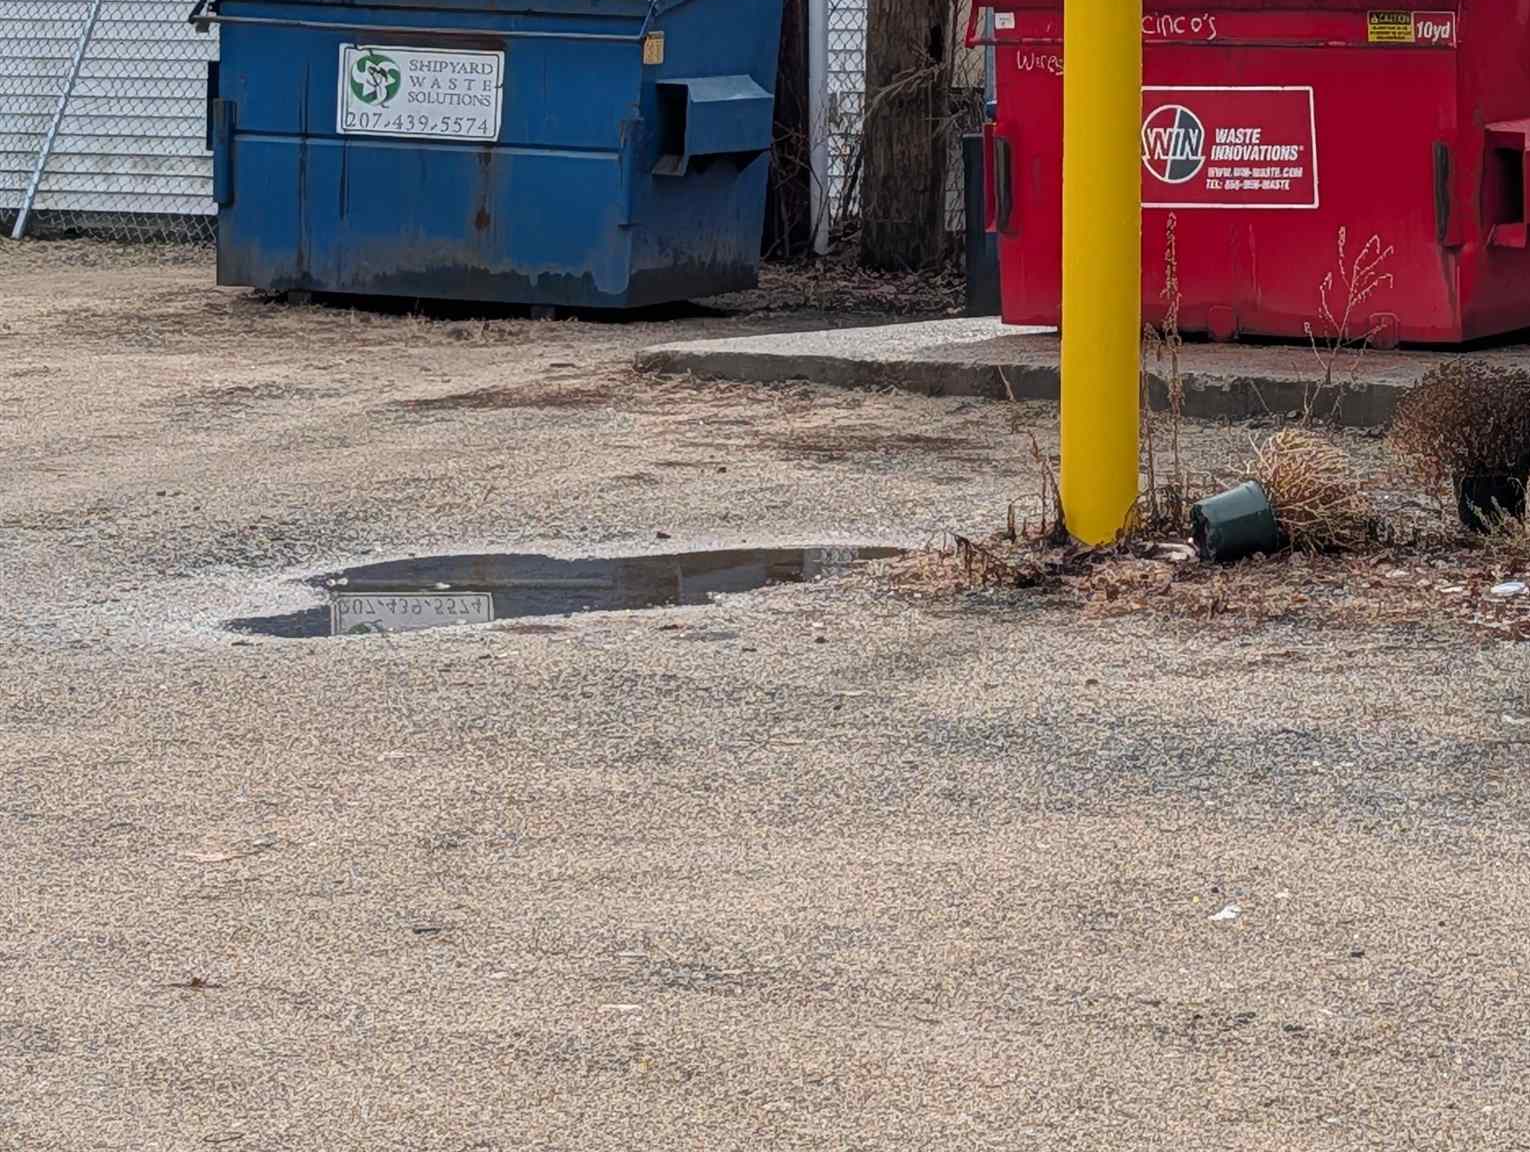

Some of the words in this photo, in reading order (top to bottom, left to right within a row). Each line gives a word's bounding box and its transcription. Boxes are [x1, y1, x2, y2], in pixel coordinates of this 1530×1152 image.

[1416, 20, 1450, 43] 10yd
[408, 59, 494, 75] SHIPYARD
[408, 75, 492, 92] WASTE
[407, 91, 492, 107] SOLUTIONS
[1146, 128, 1201, 160] WIN
[1215, 128, 1261, 144] WASTE
